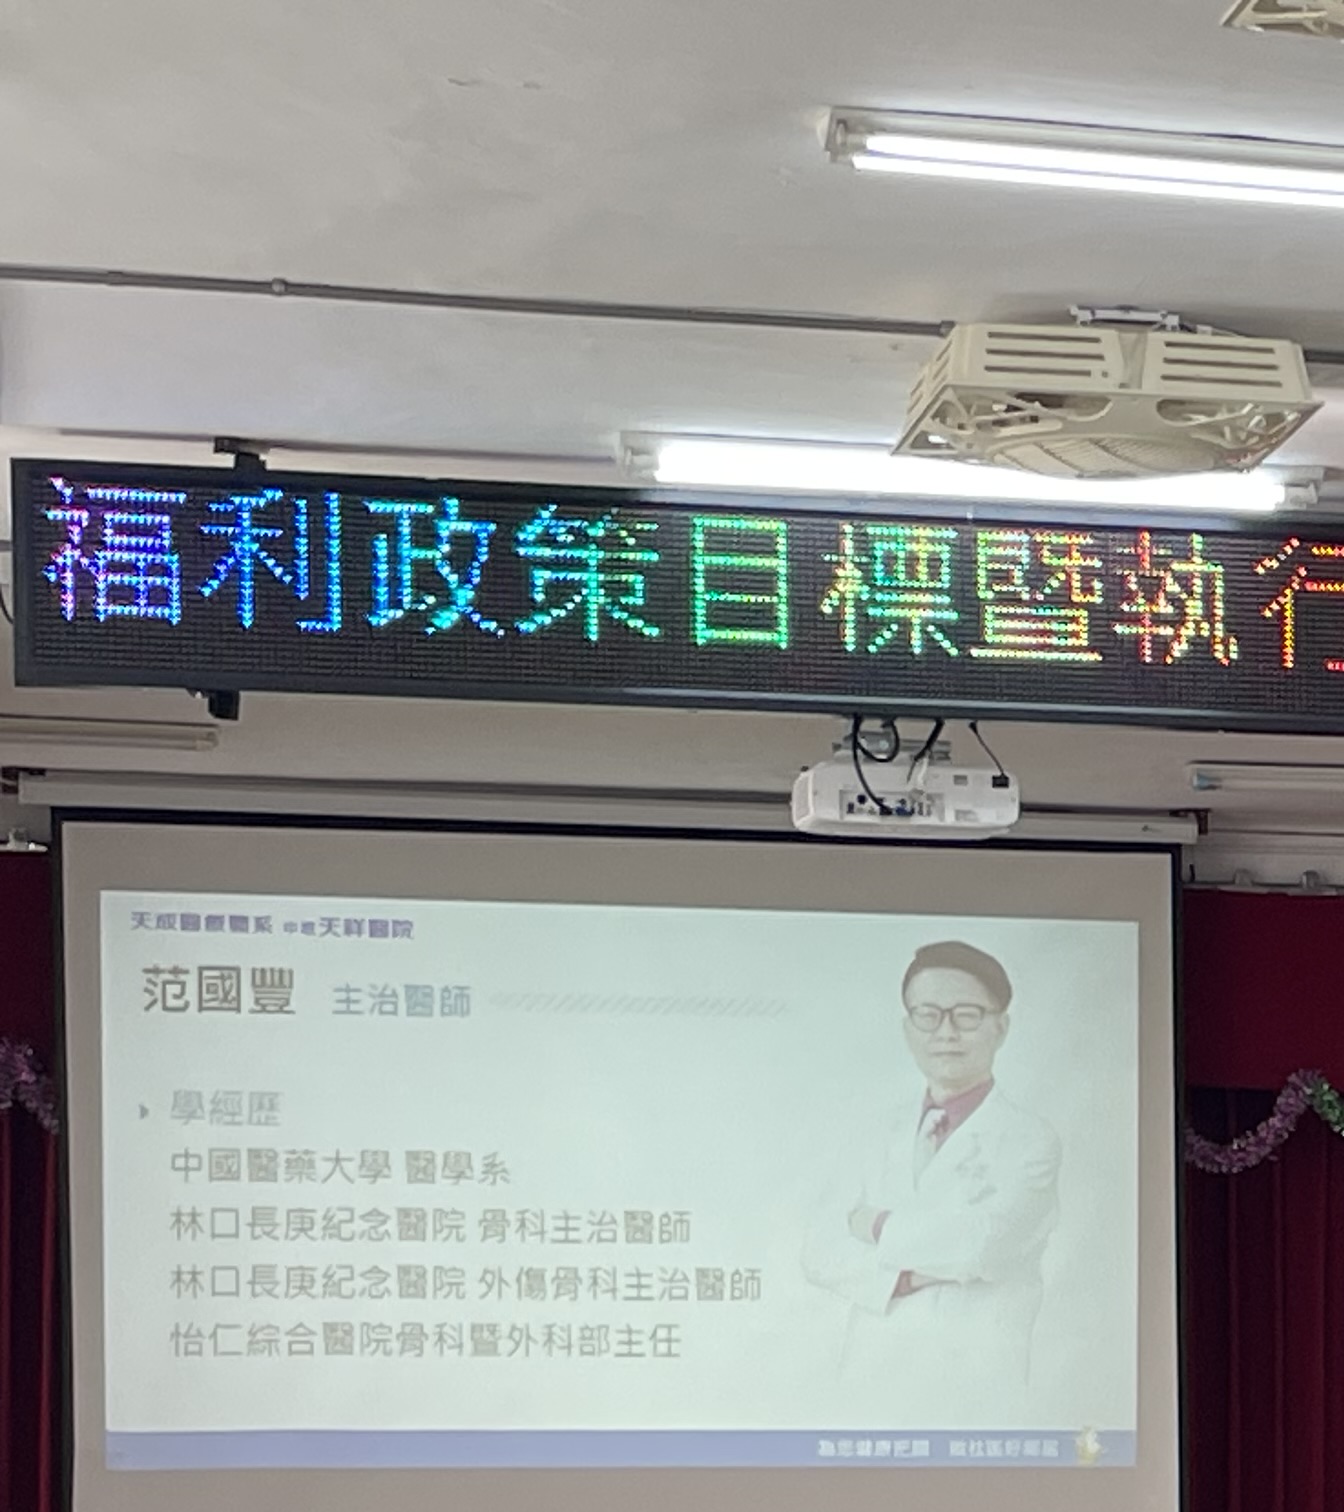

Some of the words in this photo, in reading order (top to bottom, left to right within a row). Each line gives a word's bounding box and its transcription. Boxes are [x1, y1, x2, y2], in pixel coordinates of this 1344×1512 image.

[142, 965, 297, 1015] 范國豐
[332, 983, 472, 1018] 主治醫師
[170, 1089, 283, 1127] 學經歷
[170, 1147, 392, 1185] 中國醫藥大學
[405, 1148, 511, 1186] 醫學系
[170, 1205, 466, 1244] 林口長庚紀念醫院
[478, 1208, 692, 1246] 骨科主治醫師
[170, 1264, 466, 1302] 林口長庚紀念醫院
[478, 1266, 762, 1303] 外傷骨科主治醫師
[170, 1322, 682, 1359] 怡仁綜合醫院骨科暨外科部主任
